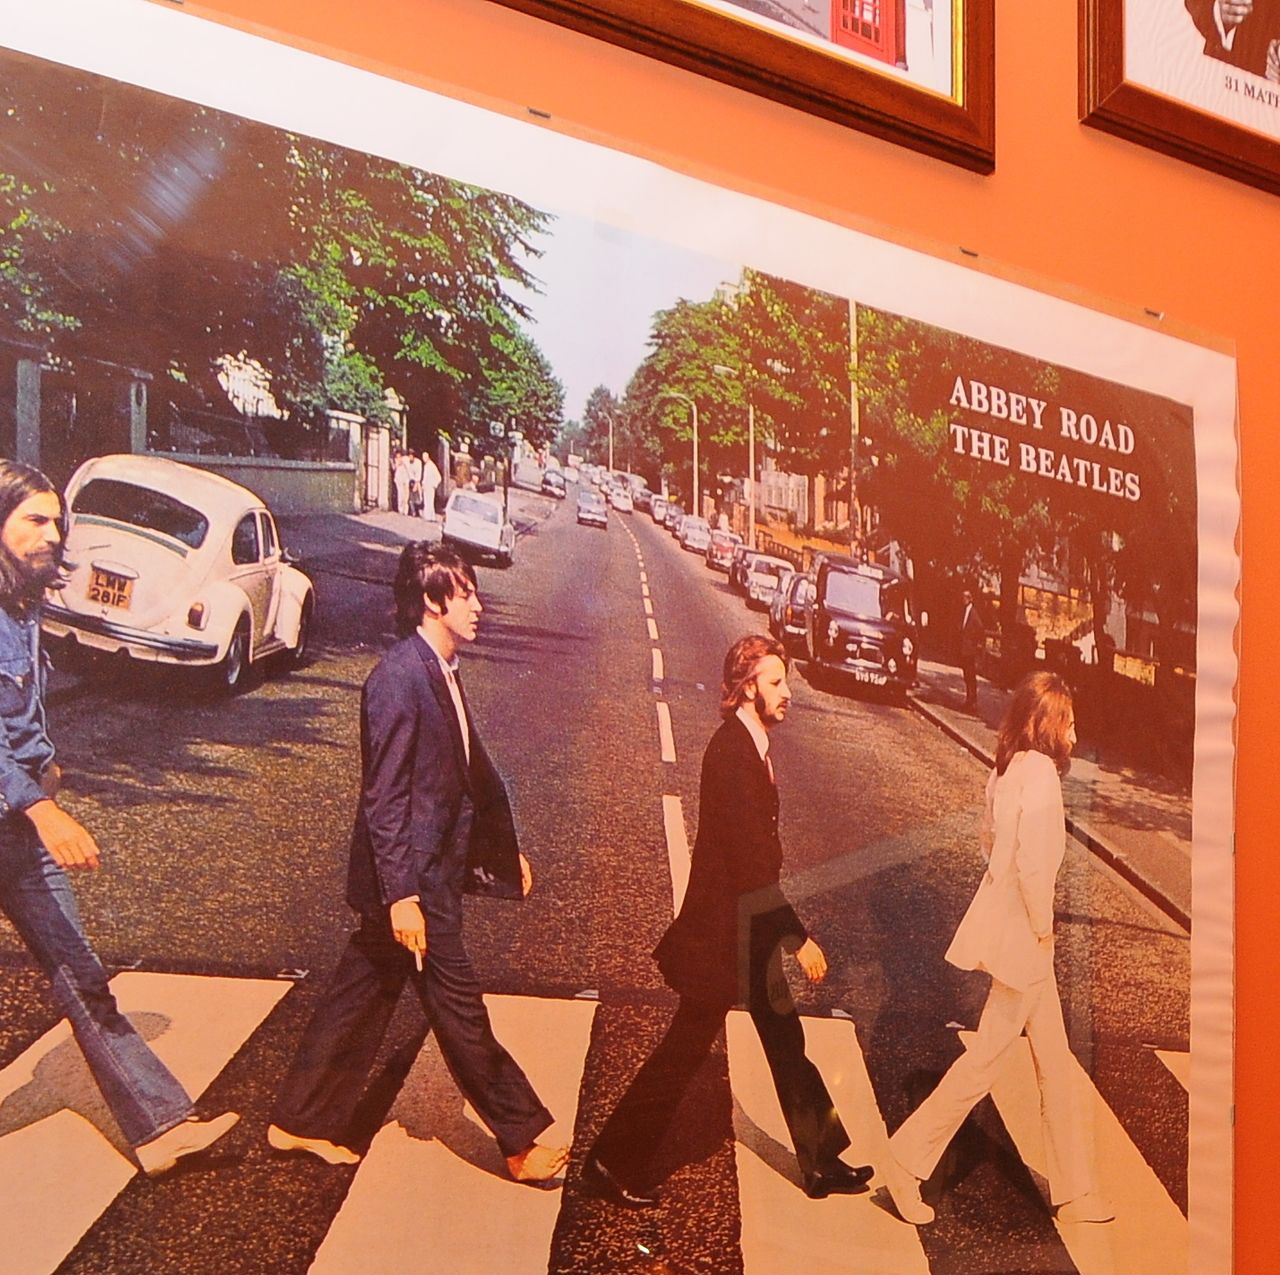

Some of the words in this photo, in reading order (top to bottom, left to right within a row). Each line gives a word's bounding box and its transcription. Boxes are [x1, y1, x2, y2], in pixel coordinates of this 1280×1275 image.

[1224, 75, 1240, 93] 31
[949, 375, 1048, 430] ABBEY
[1059, 406, 1136, 456] ROAD
[949, 423, 1011, 467] THE
[1018, 442, 1141, 502] BEATLES
[89, 587, 127, 607] 281F
